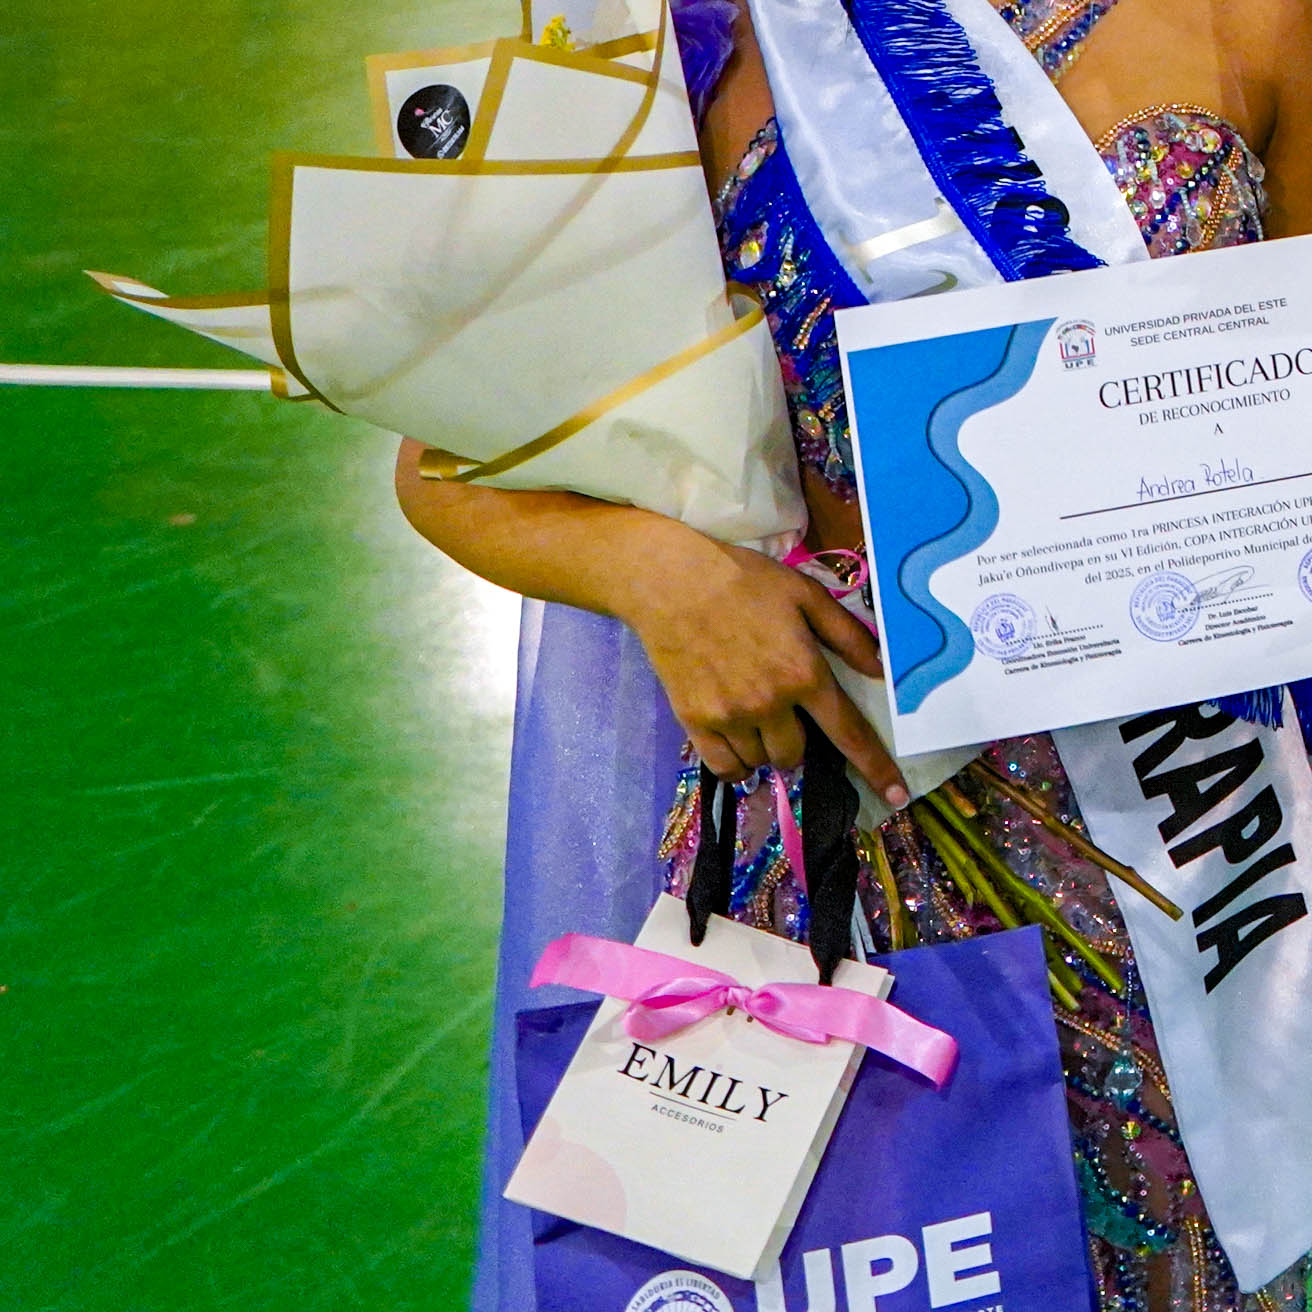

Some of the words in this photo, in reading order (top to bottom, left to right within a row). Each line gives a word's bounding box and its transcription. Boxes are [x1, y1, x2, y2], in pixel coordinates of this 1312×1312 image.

[1104, 315, 1180, 335] UNIVERSIDAD
[1183, 307, 1231, 322] PRIVADA
[1233, 304, 1255, 314] DEL
[1258, 297, 1286, 310] ESTE
[1130, 334, 1159, 346] SEDE
[1163, 324, 1214, 340] CENTRAL
[1217, 316, 1269, 331] CENTRAL
[1063, 359, 1097, 370] UPE
[1139, 411, 1157, 424] DE
[1162, 388, 1290, 421] RECONOCIMIENTO
[1213, 423, 1224, 435] A
[1137, 473, 1195, 501] Andrea
[1202, 458, 1255, 487] Rotela
[977, 555, 996, 565] Por
[1000, 552, 1017, 560] ser
[1021, 536, 1092, 556] seleccionada
[1096, 532, 1127, 543] como
[1131, 528, 1148, 537] 1ra
[1152, 516, 1208, 534] PRINCESA
[1212, 500, 1290, 523] INTEGRACIÓN
[617, 1041, 790, 1124] EMILY
[650, 1103, 726, 1135] ACCESORIOS
[756, 1211, 1002, 1312] UPE
